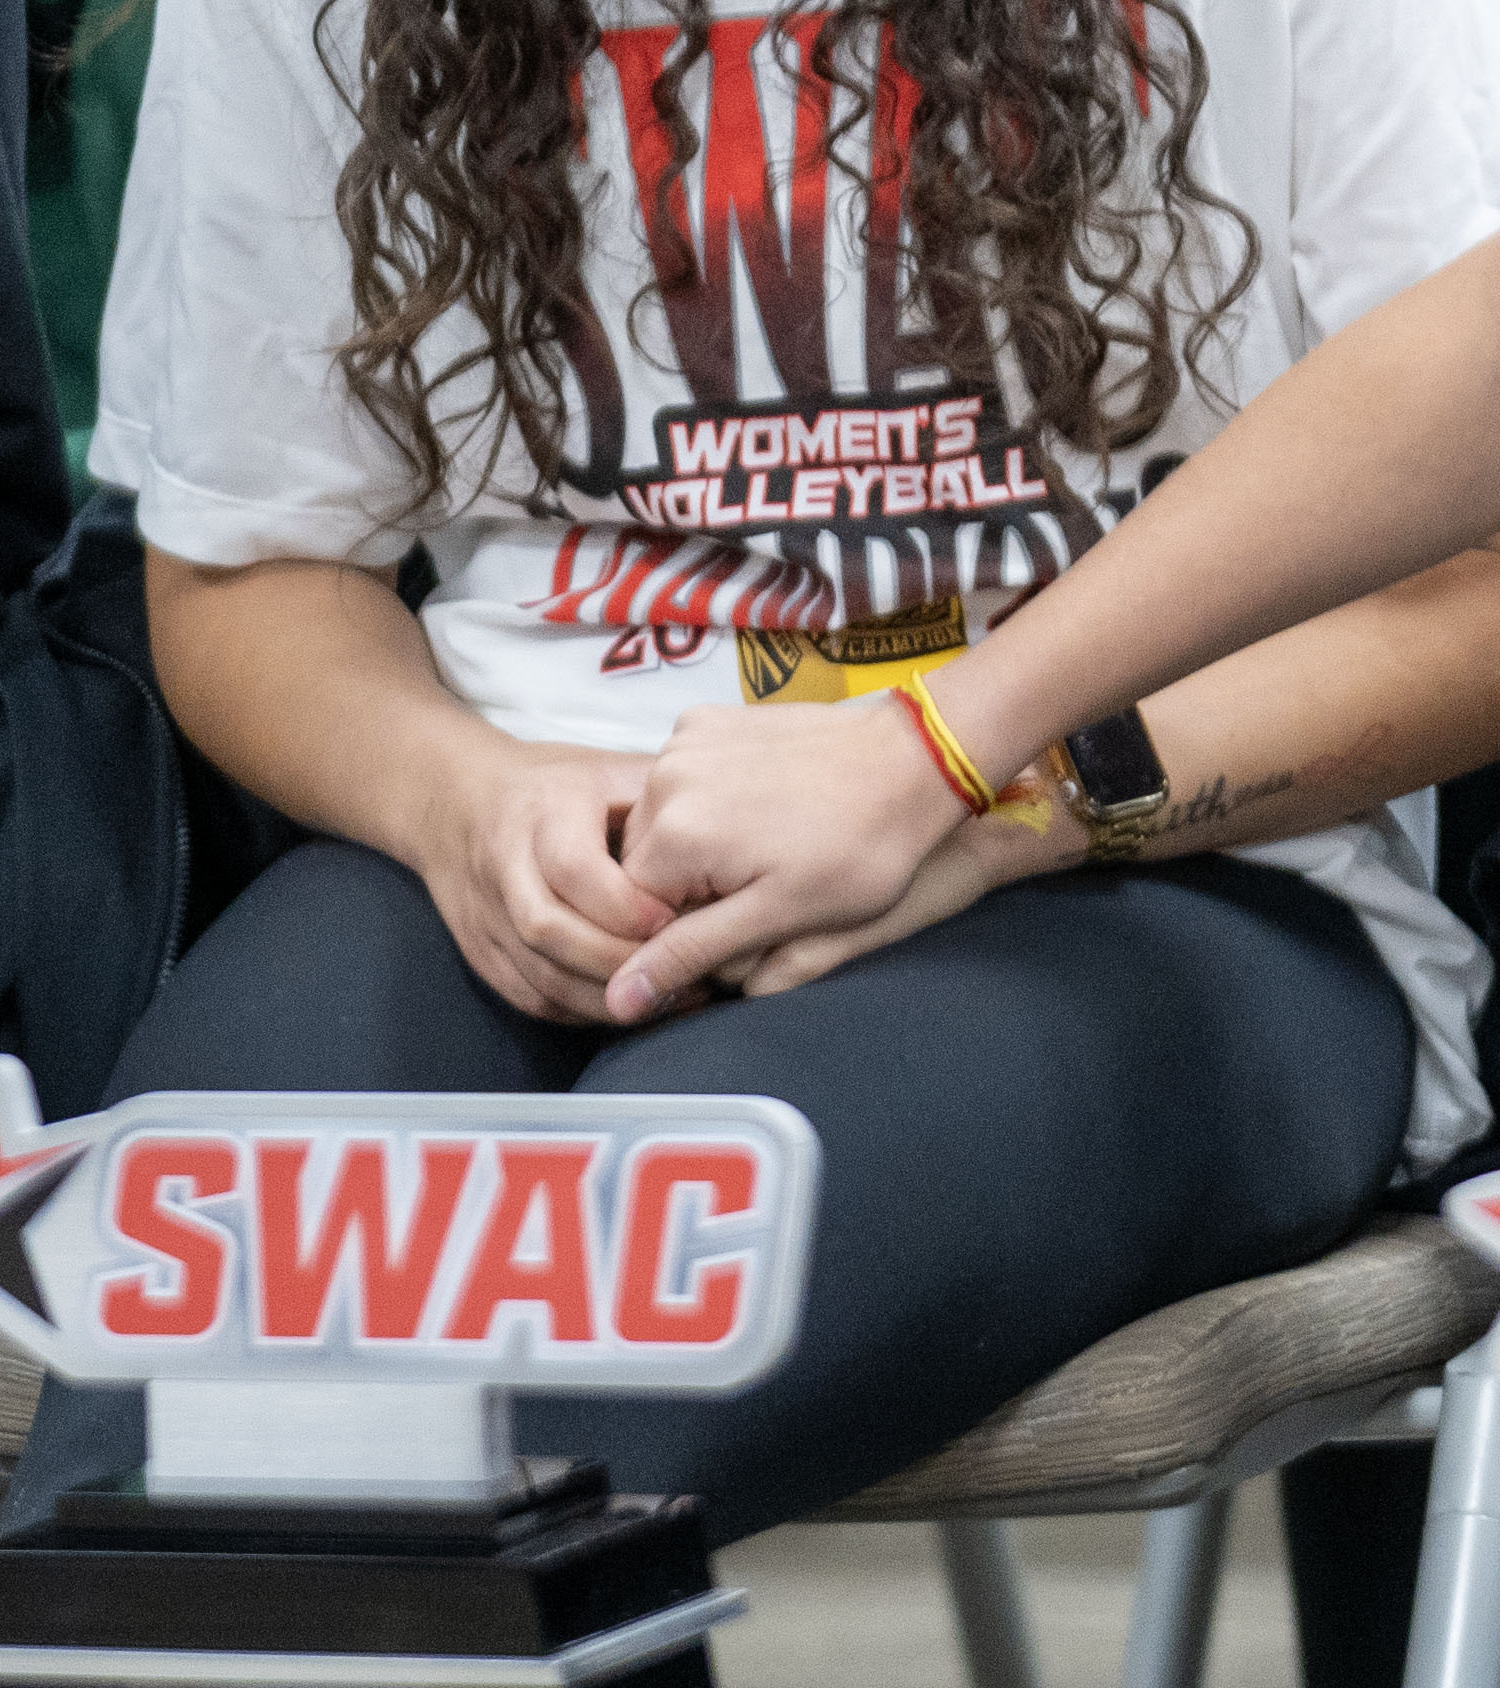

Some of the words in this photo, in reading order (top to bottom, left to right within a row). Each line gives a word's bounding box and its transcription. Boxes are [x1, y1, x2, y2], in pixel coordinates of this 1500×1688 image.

[666, 394, 984, 474] WOMEN'S
[624, 446, 1049, 530] VOLLEYBALL
[846, 623, 962, 658] CHAMPION
[100, 1134, 758, 1344] SWAC
